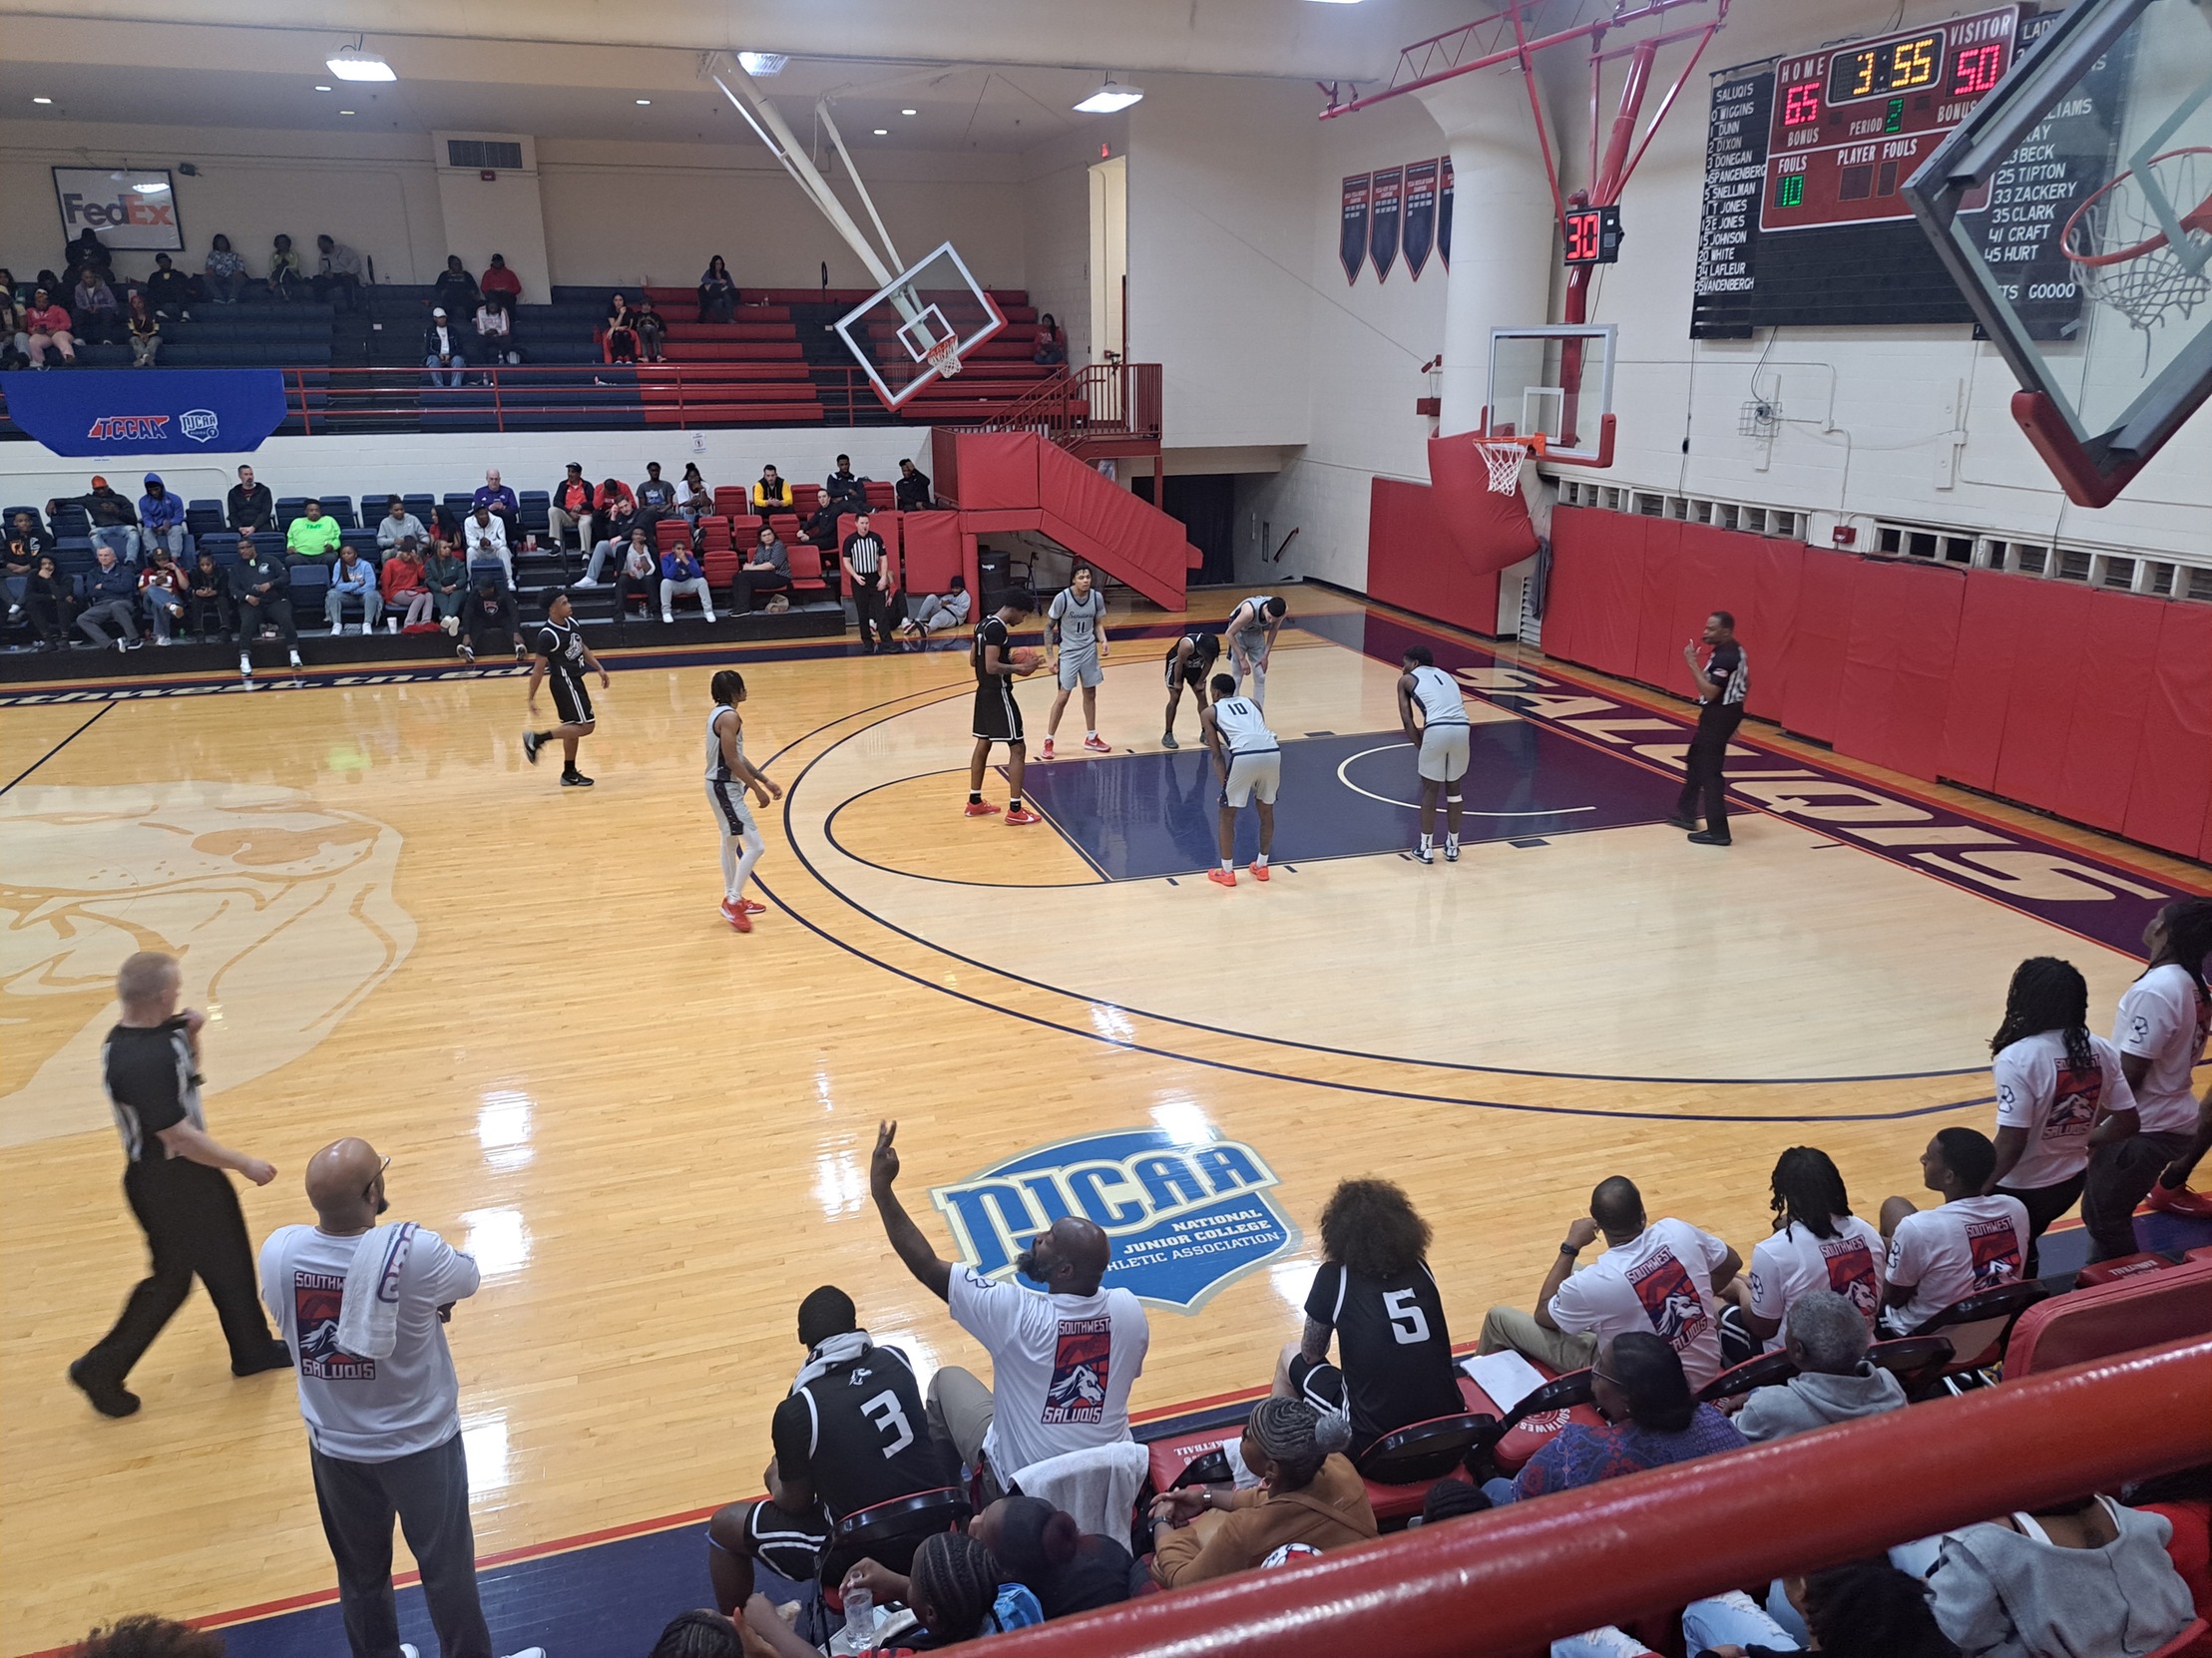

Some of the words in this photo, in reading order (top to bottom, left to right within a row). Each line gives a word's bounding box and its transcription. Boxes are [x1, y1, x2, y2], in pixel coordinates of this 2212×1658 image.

[1951, 14, 2011, 46] VISITOR
[2022, 18, 2055, 40] LAD
[1781, 57, 1826, 83] HOME
[1853, 38, 1934, 95] 3:55
[1954, 44, 2001, 95] 50
[1719, 102, 1754, 120] WIGGINS
[1784, 82, 1820, 126] 65
[1885, 99, 1904, 134] 2
[1718, 121, 1740, 136] DUNN
[1849, 118, 1883, 137] PERIOD
[1707, 142, 1714, 154] 2
[1717, 136, 1742, 152] DIXON
[1787, 128, 1819, 148] BONUS
[1707, 157, 1713, 170] 3
[1714, 150, 1753, 168] DONEGAN
[1837, 145, 1876, 166] PLAYER
[1883, 139, 1918, 160] FOULS
[2019, 144, 2054, 162] BECK
[1777, 156, 1807, 174] FOULS
[1996, 169, 2014, 185] 25
[2018, 163, 2066, 183] TIPTON
[1704, 189, 1710, 201] 5
[1712, 182, 1756, 200] SNELLMAN
[1782, 175, 1804, 206] 10
[1993, 189, 2012, 205] 33
[2013, 182, 2077, 203] ZACKERY
[62, 193, 174, 226] FedEx
[1720, 200, 1747, 213] JONES
[1991, 207, 2009, 223] 35
[2011, 204, 2055, 220] CLARK
[1718, 214, 1745, 229] JONES
[1566, 213, 1598, 259] 30
[1699, 234, 1709, 246] 15
[1710, 230, 1747, 245] JOHNSON
[1989, 227, 2003, 242] 41
[2007, 223, 2050, 241] CRAFT
[1697, 250, 1709, 262] 20
[1711, 247, 1735, 261] WHITE
[1985, 247, 2001, 262] 45
[2003, 244, 2038, 261] HURT
[1697, 264, 1708, 277] 34
[1709, 262, 1746, 276] LAFLEUR
[1997, 284, 2018, 299] TS
[99, 418, 168, 441] TCCAA
[1433, 674, 1444, 686] 1
[1226, 702, 1248, 716] 10
[1171, 1209, 1262, 1232] NATIONAL
[1967, 1217, 2013, 1238] SOUTHWEST
[1123, 1235, 1192, 1254] JUNIOR
[1193, 1220, 1272, 1241] COLLEGE
[1107, 1253, 1167, 1271] HLETIC
[1172, 1232, 1280, 1259] ASSOCIATION
[1626, 1246, 1673, 1284] SOUTHWEST
[295, 1272, 345, 1291] SOUTHW
[1383, 1287, 1431, 1345] 5
[1059, 1318, 1110, 1335] SOUTHWEST
[1667, 1316, 1708, 1352] ALUQIS
[859, 1389, 915, 1459] 3
[1519, 1408, 1571, 1434] SOUTHWES
[1173, 1440, 1224, 1456] KETBALL
